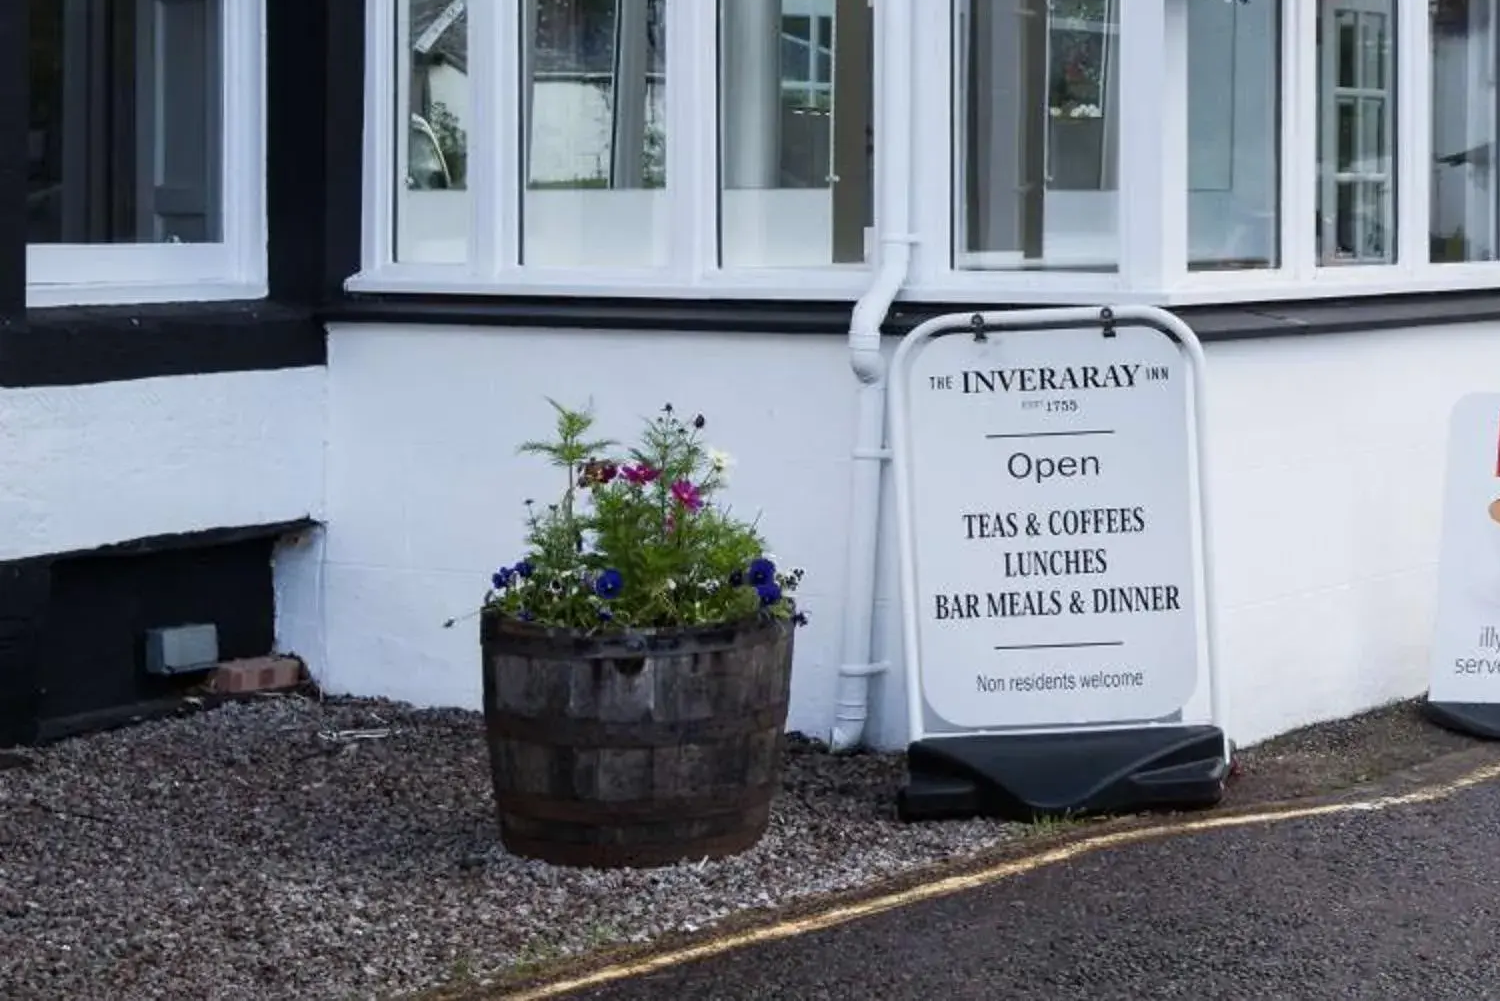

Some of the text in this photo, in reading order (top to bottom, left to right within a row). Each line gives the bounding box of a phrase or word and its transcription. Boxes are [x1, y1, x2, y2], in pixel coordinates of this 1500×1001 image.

[929, 364, 1169, 394] THE INVERARAY INN
[1007, 452, 1101, 483] Open
[962, 506, 1145, 539] TEAS & COFFEES
[1003, 548, 1108, 578] LUNCHES
[934, 585, 1181, 620] BAR MEALS & DINNER
[976, 669, 1145, 692] Non residents welcome
